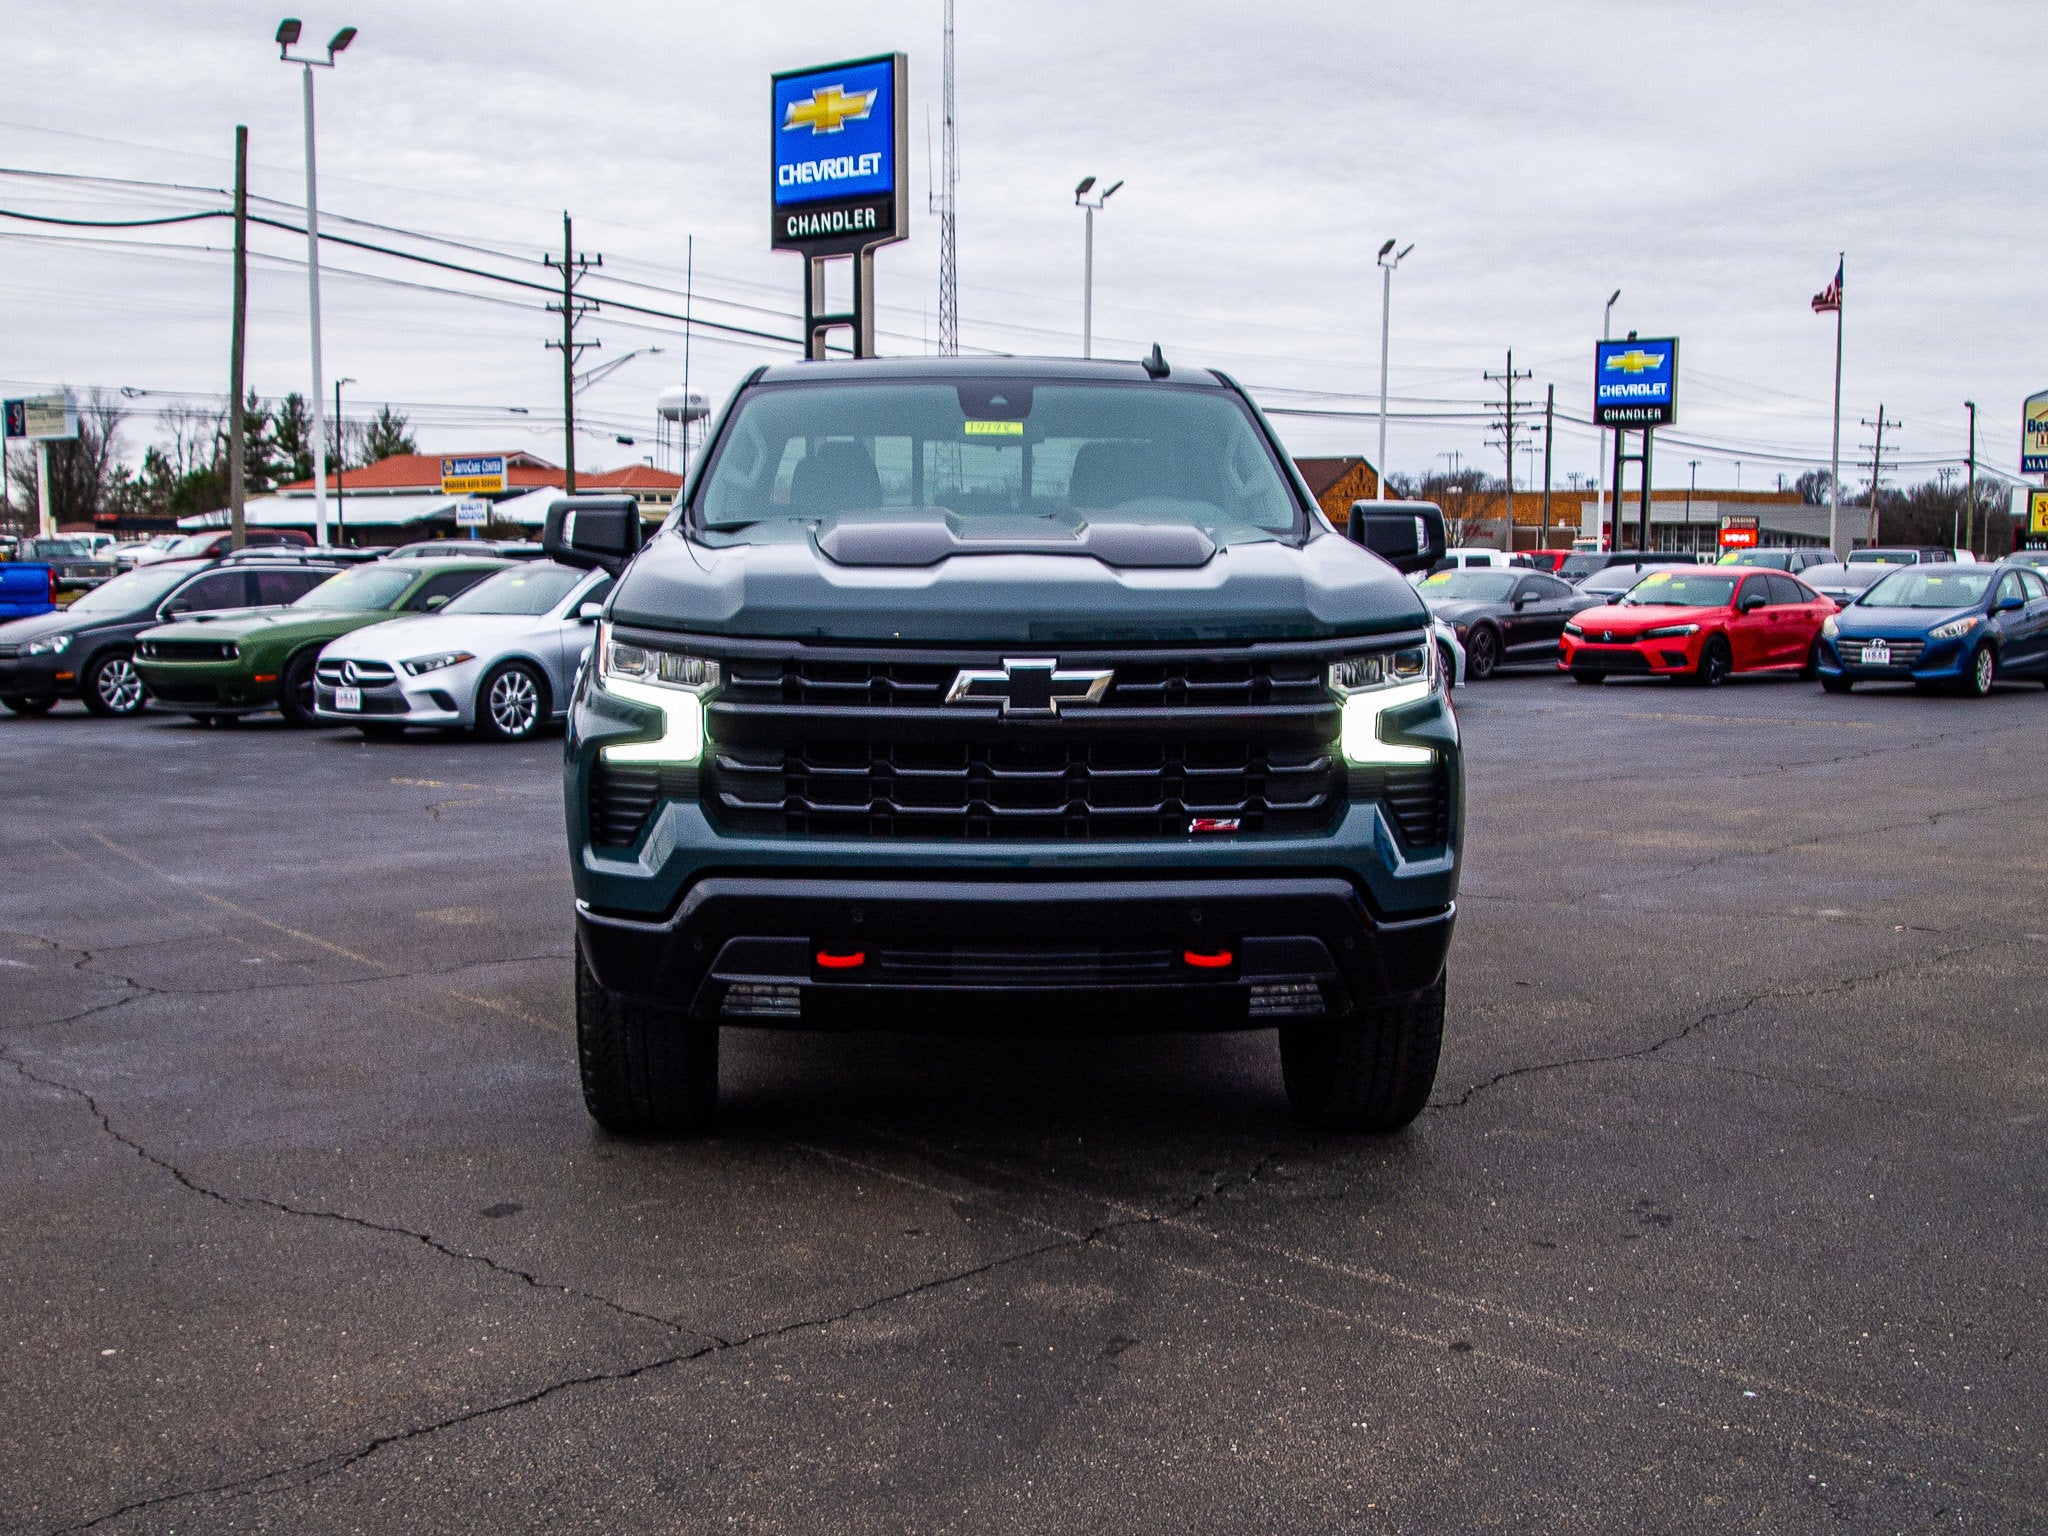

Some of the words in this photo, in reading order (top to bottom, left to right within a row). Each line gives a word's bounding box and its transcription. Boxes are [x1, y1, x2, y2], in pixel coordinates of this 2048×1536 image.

[778, 152, 882, 187] CHEVROLET
[786, 207, 876, 237] CHANDLER
[1600, 382, 1668, 398] CHEVROLET
[1604, 408, 1662, 421] CHANDLER
